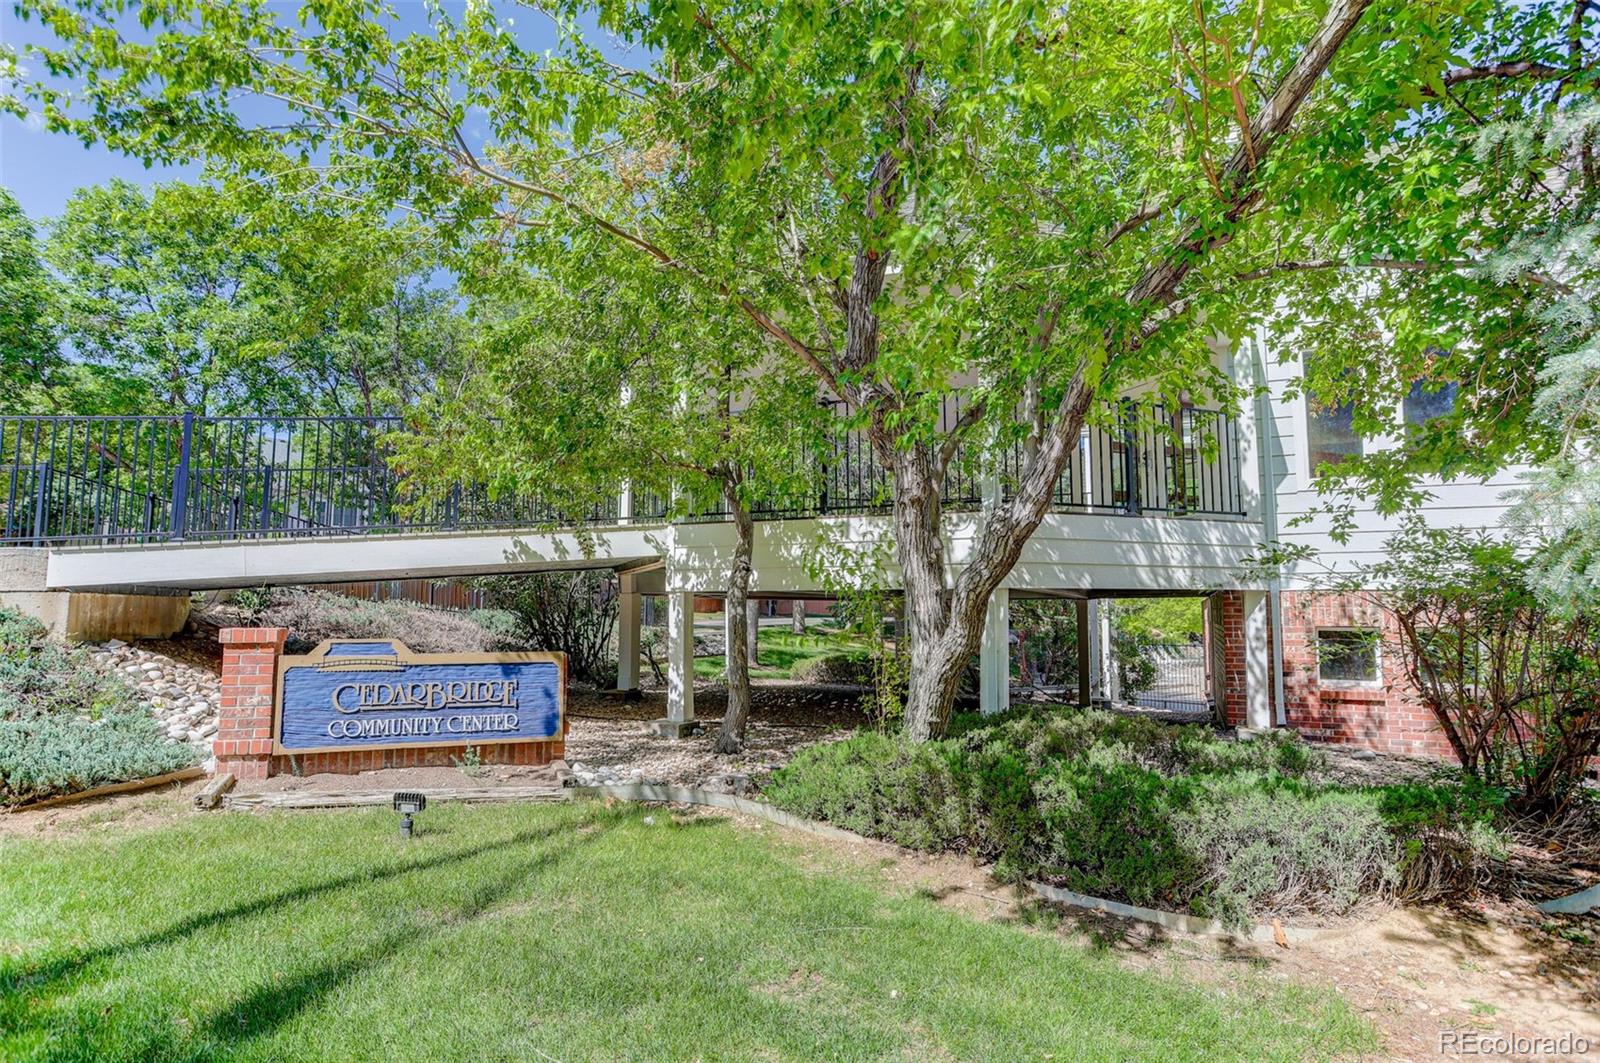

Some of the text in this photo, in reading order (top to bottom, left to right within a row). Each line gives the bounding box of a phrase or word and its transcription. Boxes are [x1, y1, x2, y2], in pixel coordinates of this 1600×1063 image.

[331, 680, 519, 714] CEDARBRIDGE
[328, 713, 519, 738] COMMUNITY CENTER
